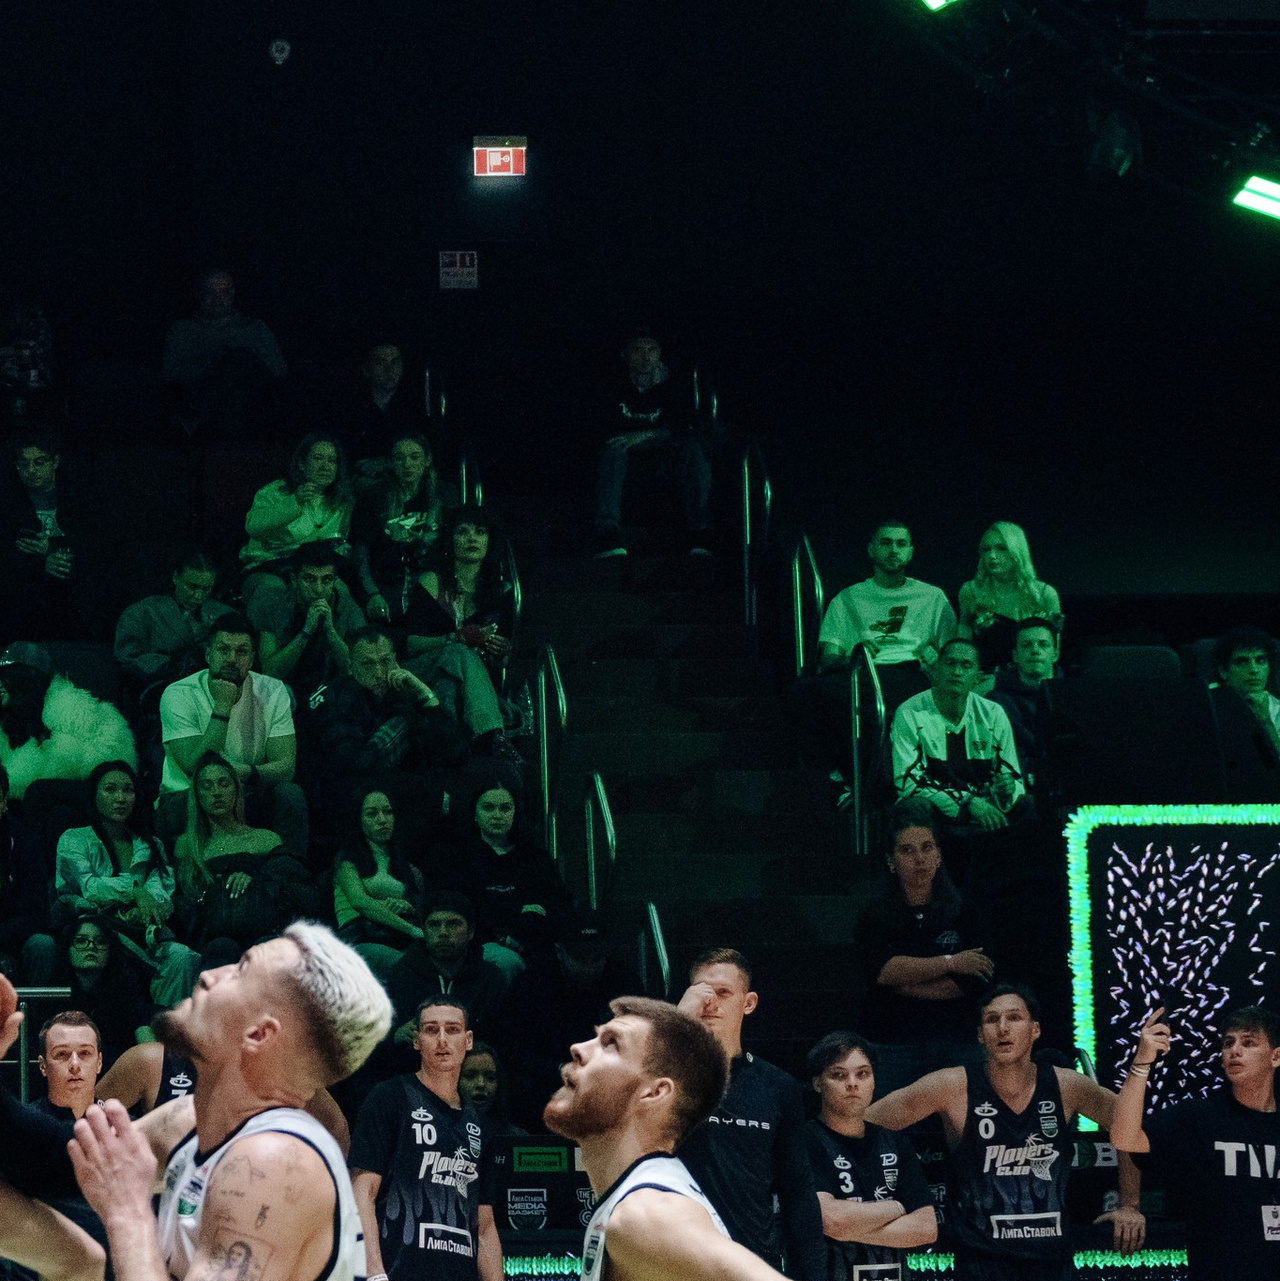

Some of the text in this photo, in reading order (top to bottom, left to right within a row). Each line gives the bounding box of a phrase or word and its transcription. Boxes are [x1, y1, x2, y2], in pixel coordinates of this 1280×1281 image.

[411, 1123, 437, 1145] 10
[978, 1118, 995, 1140] 0
[983, 1143, 1054, 1173] Players
[839, 1172, 854, 1193] 3
